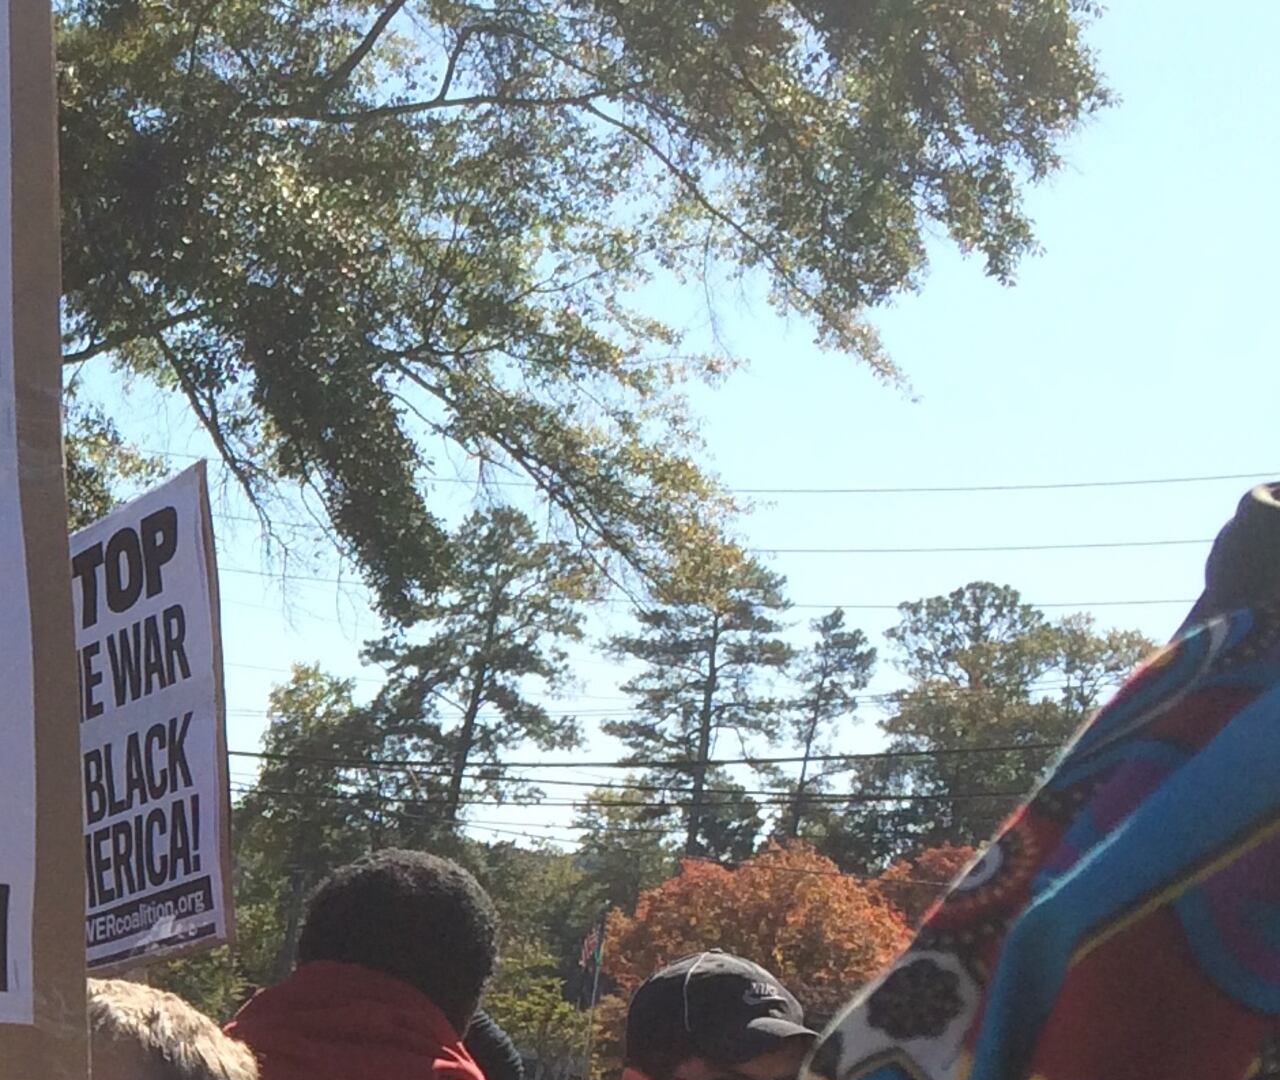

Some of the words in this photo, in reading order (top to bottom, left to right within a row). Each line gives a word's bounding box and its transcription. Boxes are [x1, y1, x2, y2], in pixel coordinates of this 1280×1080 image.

[72, 506, 177, 629] TOP
[107, 604, 191, 707] WAR
[84, 711, 193, 826] BLACK
[85, 794, 201, 908] ERICA!
